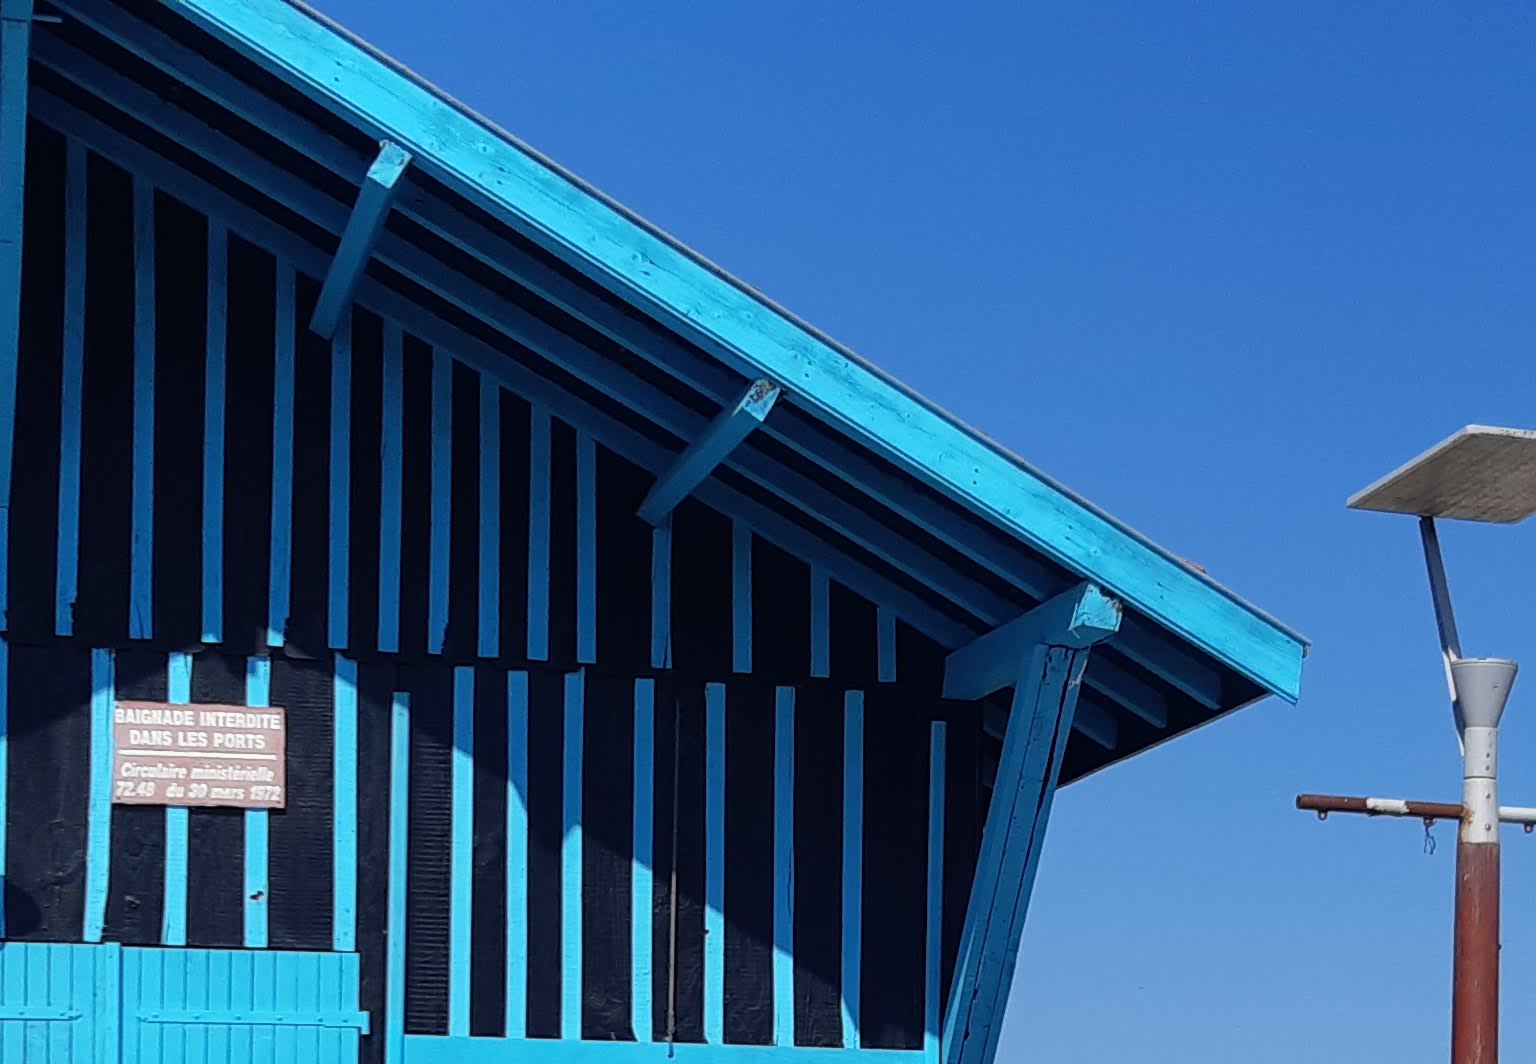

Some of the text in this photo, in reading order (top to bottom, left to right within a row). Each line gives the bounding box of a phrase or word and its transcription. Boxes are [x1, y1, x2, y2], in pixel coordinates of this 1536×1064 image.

[115, 708, 281, 729] BAIGNADE INTERDITE
[129, 729, 266, 749] DANS LES PORTS
[121, 761, 187, 779] Circulaire
[165, 783, 185, 798] du
[210, 787, 245, 799] mars
